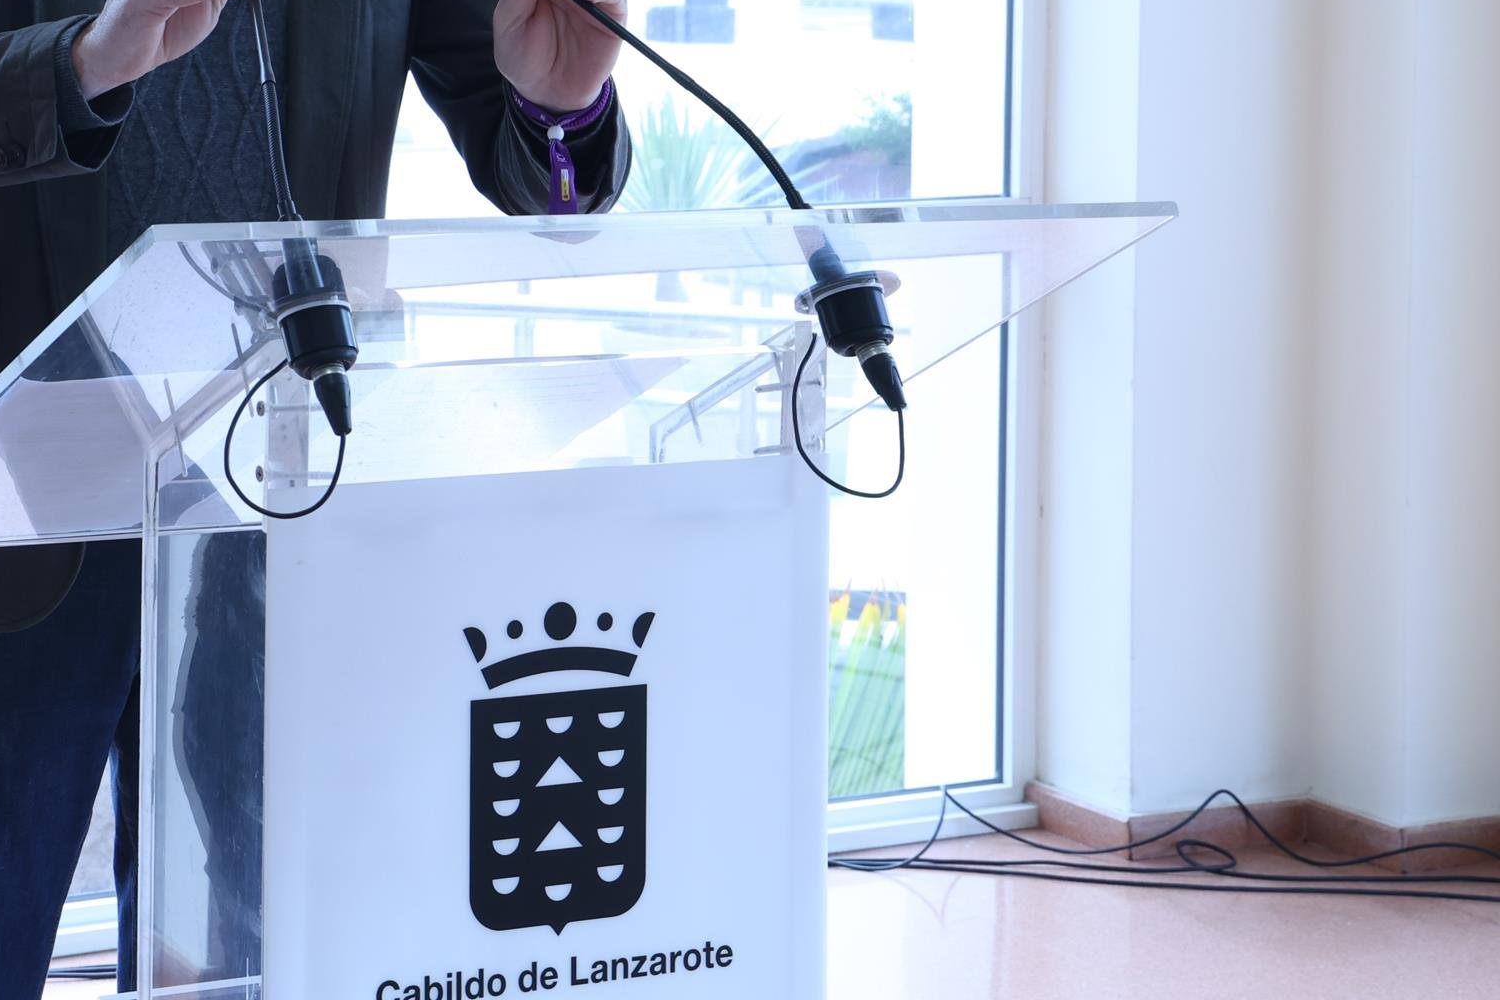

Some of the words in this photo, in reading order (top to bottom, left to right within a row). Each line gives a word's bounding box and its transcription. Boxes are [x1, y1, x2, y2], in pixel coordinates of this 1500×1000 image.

[375, 968, 507, 1000] Cabildo
[518, 961, 559, 993] de
[570, 941, 734, 987] Lanzarote
